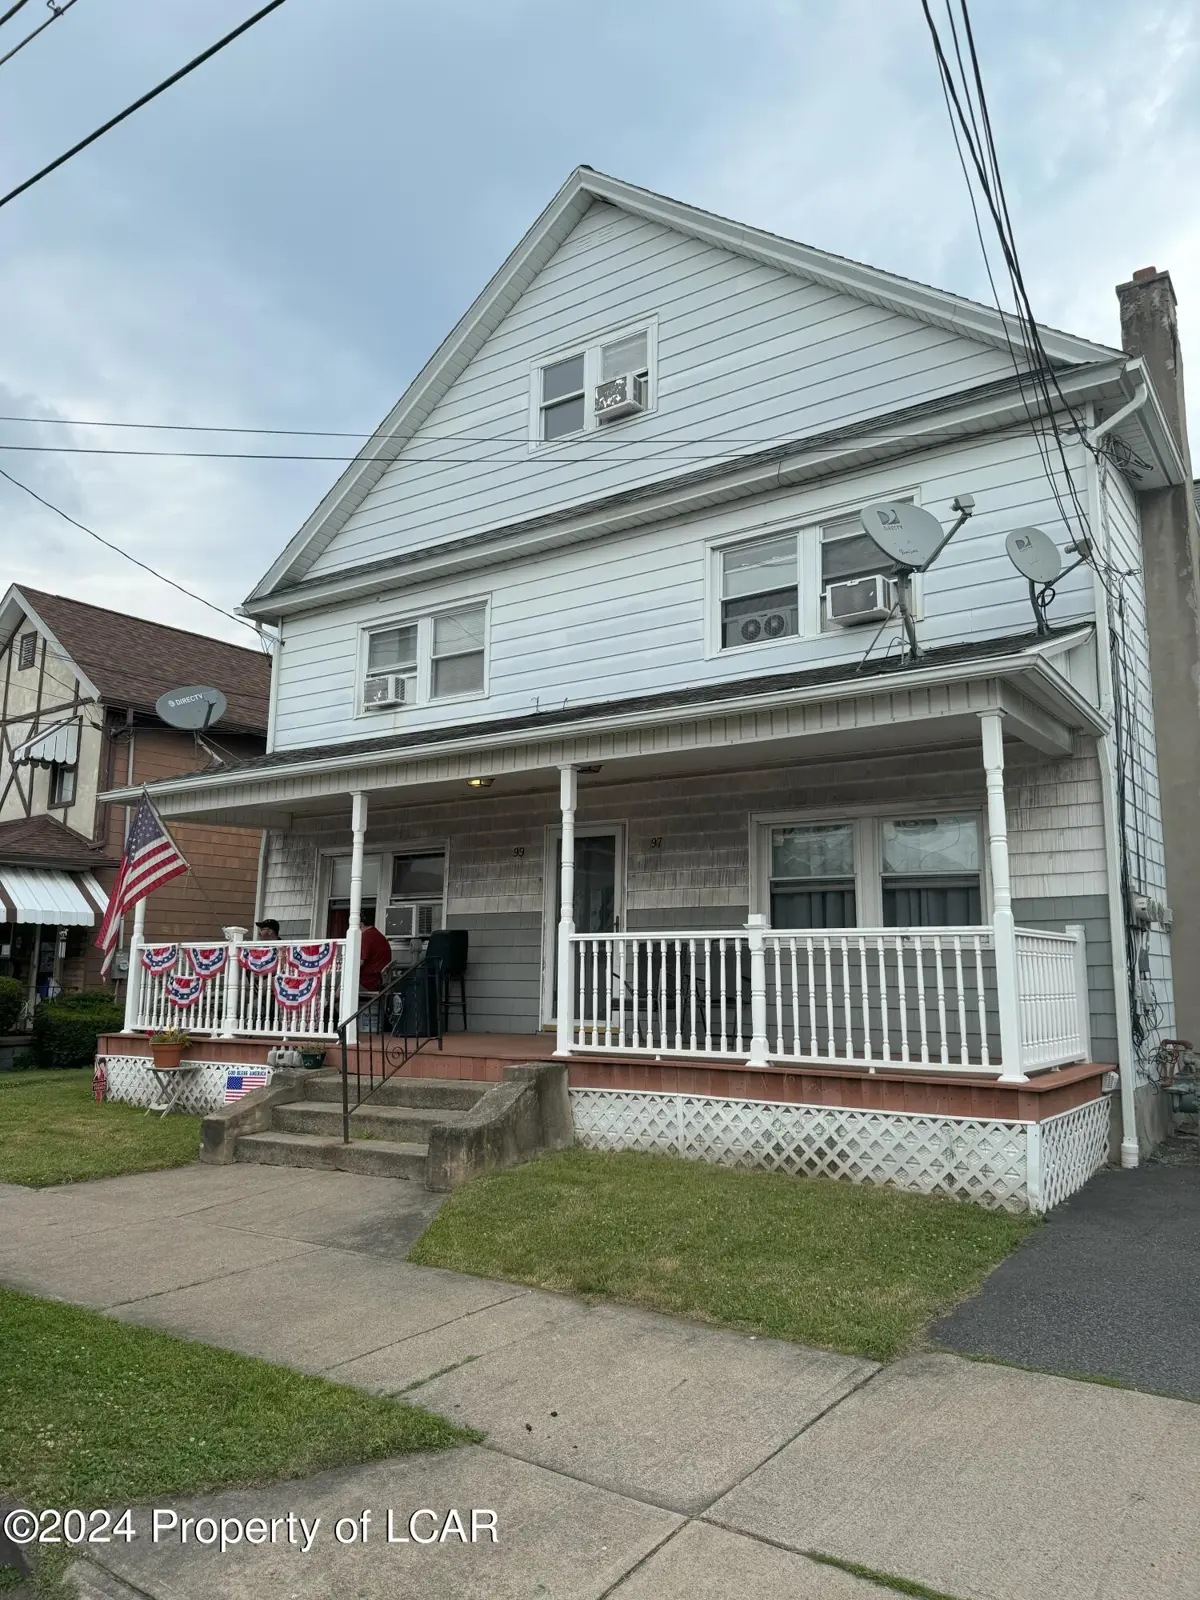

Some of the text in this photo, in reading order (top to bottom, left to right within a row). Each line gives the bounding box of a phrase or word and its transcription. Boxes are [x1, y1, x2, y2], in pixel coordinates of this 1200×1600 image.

[175, 693, 203, 706] DIRECTV
[651, 837, 663, 849] 97
[513, 847, 525, 858] 99
